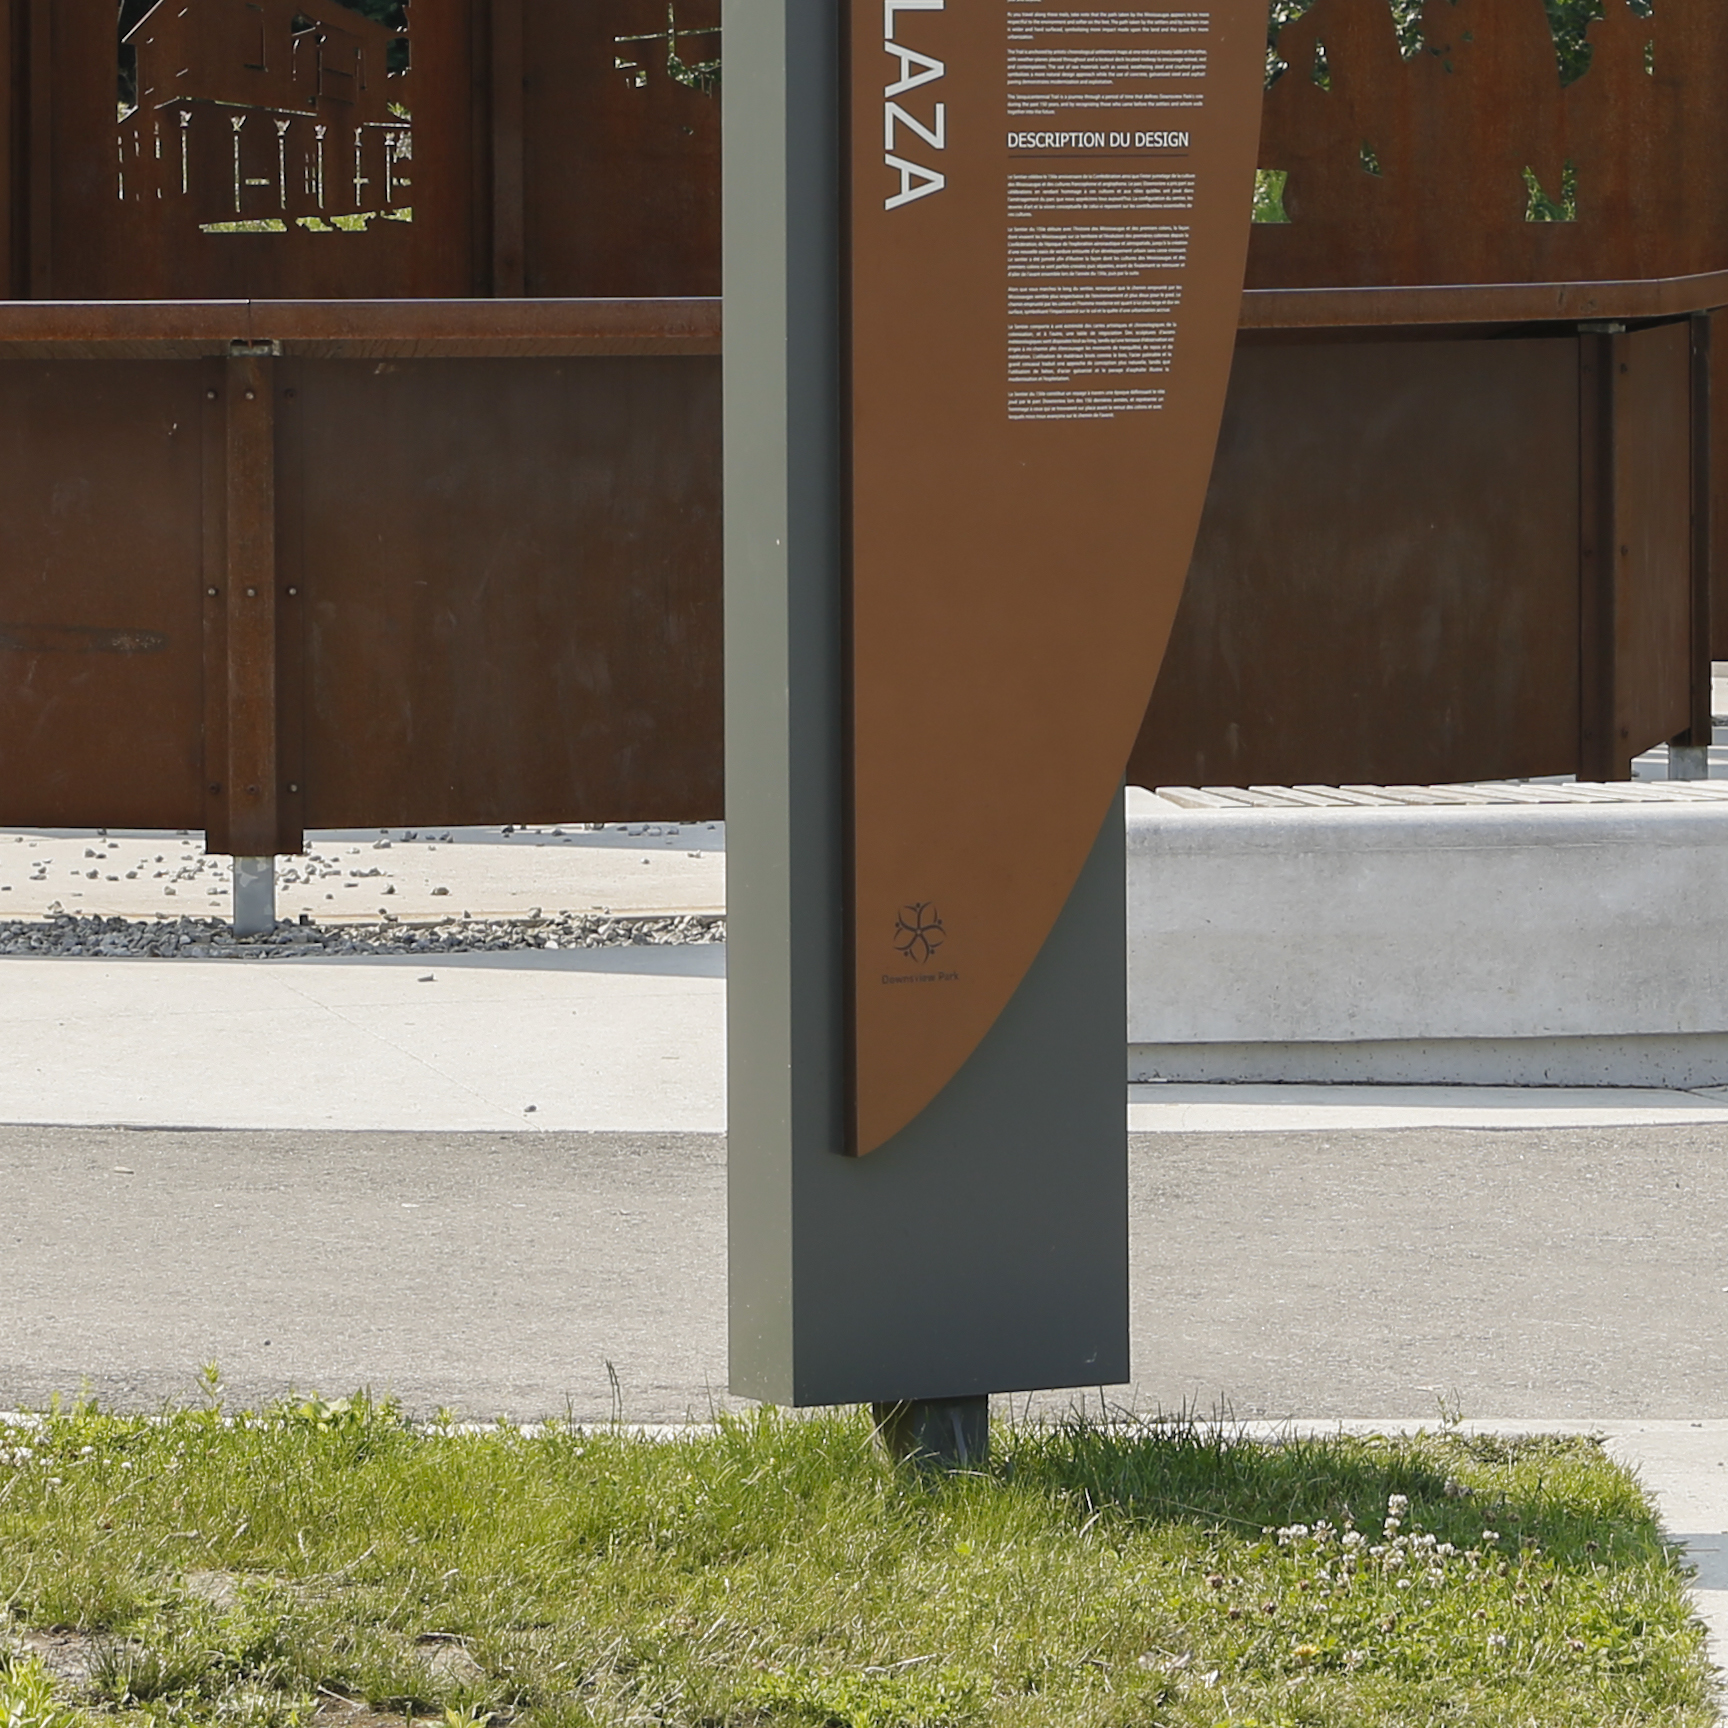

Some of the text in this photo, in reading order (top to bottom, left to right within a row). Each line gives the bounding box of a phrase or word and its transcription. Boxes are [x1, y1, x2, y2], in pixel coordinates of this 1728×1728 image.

[1007, 131, 1189, 148] DESCRIPTION DU DESIGN
[881, 971, 959, 985] Downsview Park
